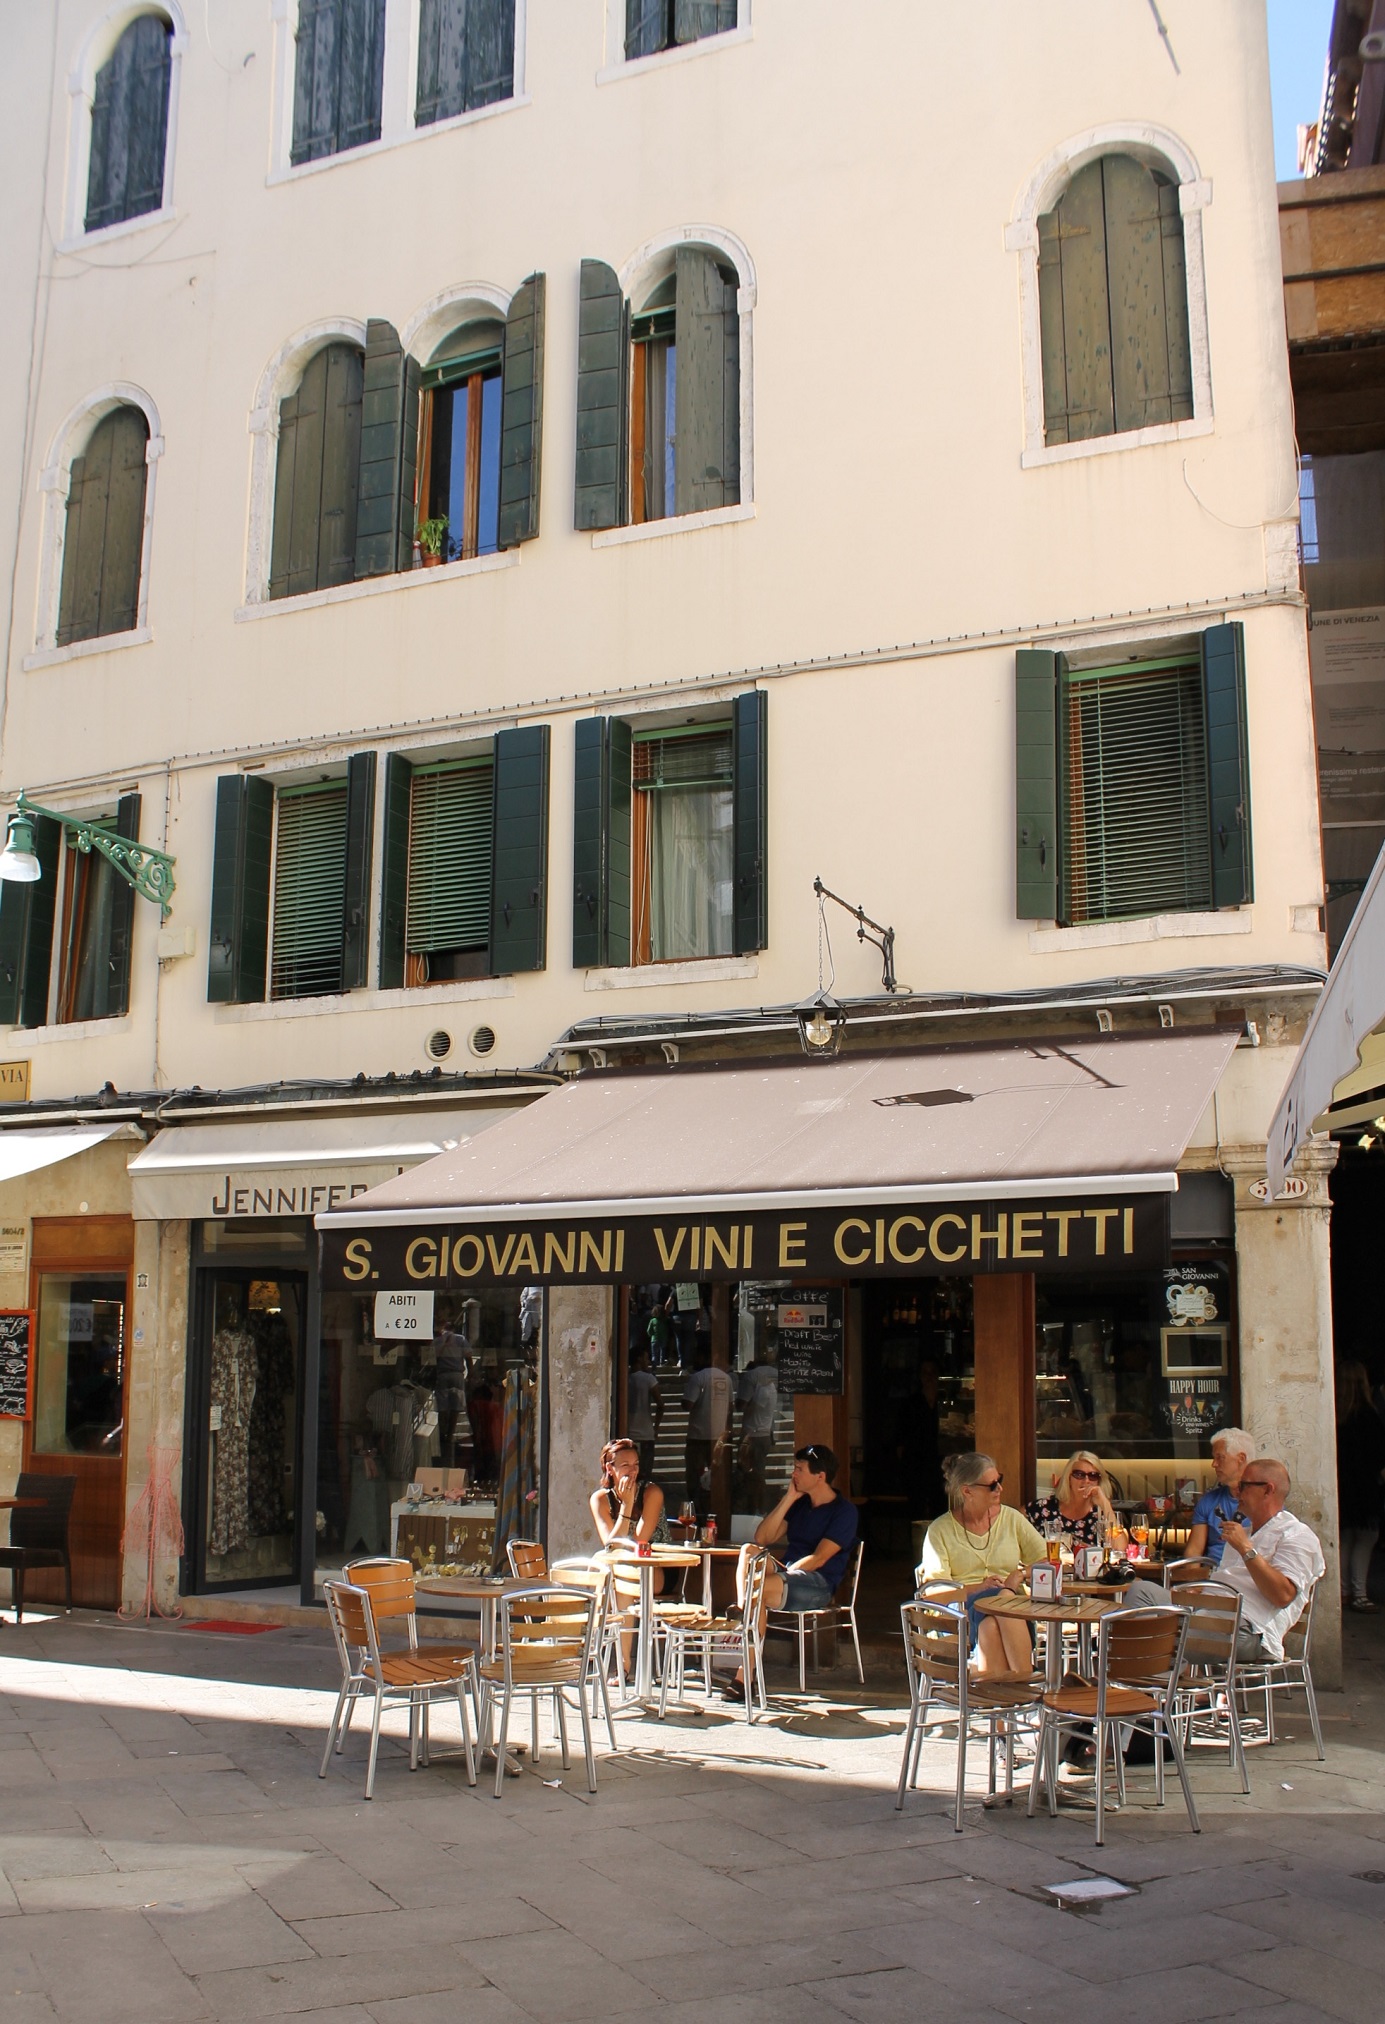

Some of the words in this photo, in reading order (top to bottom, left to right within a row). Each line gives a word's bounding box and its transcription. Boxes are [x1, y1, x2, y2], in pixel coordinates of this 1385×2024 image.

[1333, 617, 1342, 625] DI
[1343, 615, 1380, 624] VENEZIA
[1, 1069, 23, 1083] VIA
[343, 1238, 379, 1280] S.
[405, 1229, 625, 1279] GIOVANNI
[653, 1224, 753, 1271] VINI
[778, 1222, 807, 1268] E
[833, 1207, 1134, 1265] CICCHETTI
[389, 1295, 416, 1306] ABITI
[1169, 1379, 1196, 1394] HAPPY
[1197, 1379, 1220, 1393] HOUR
[1181, 1415, 1202, 1423] Drinks
[1185, 1427, 1203, 1435] Spritz
